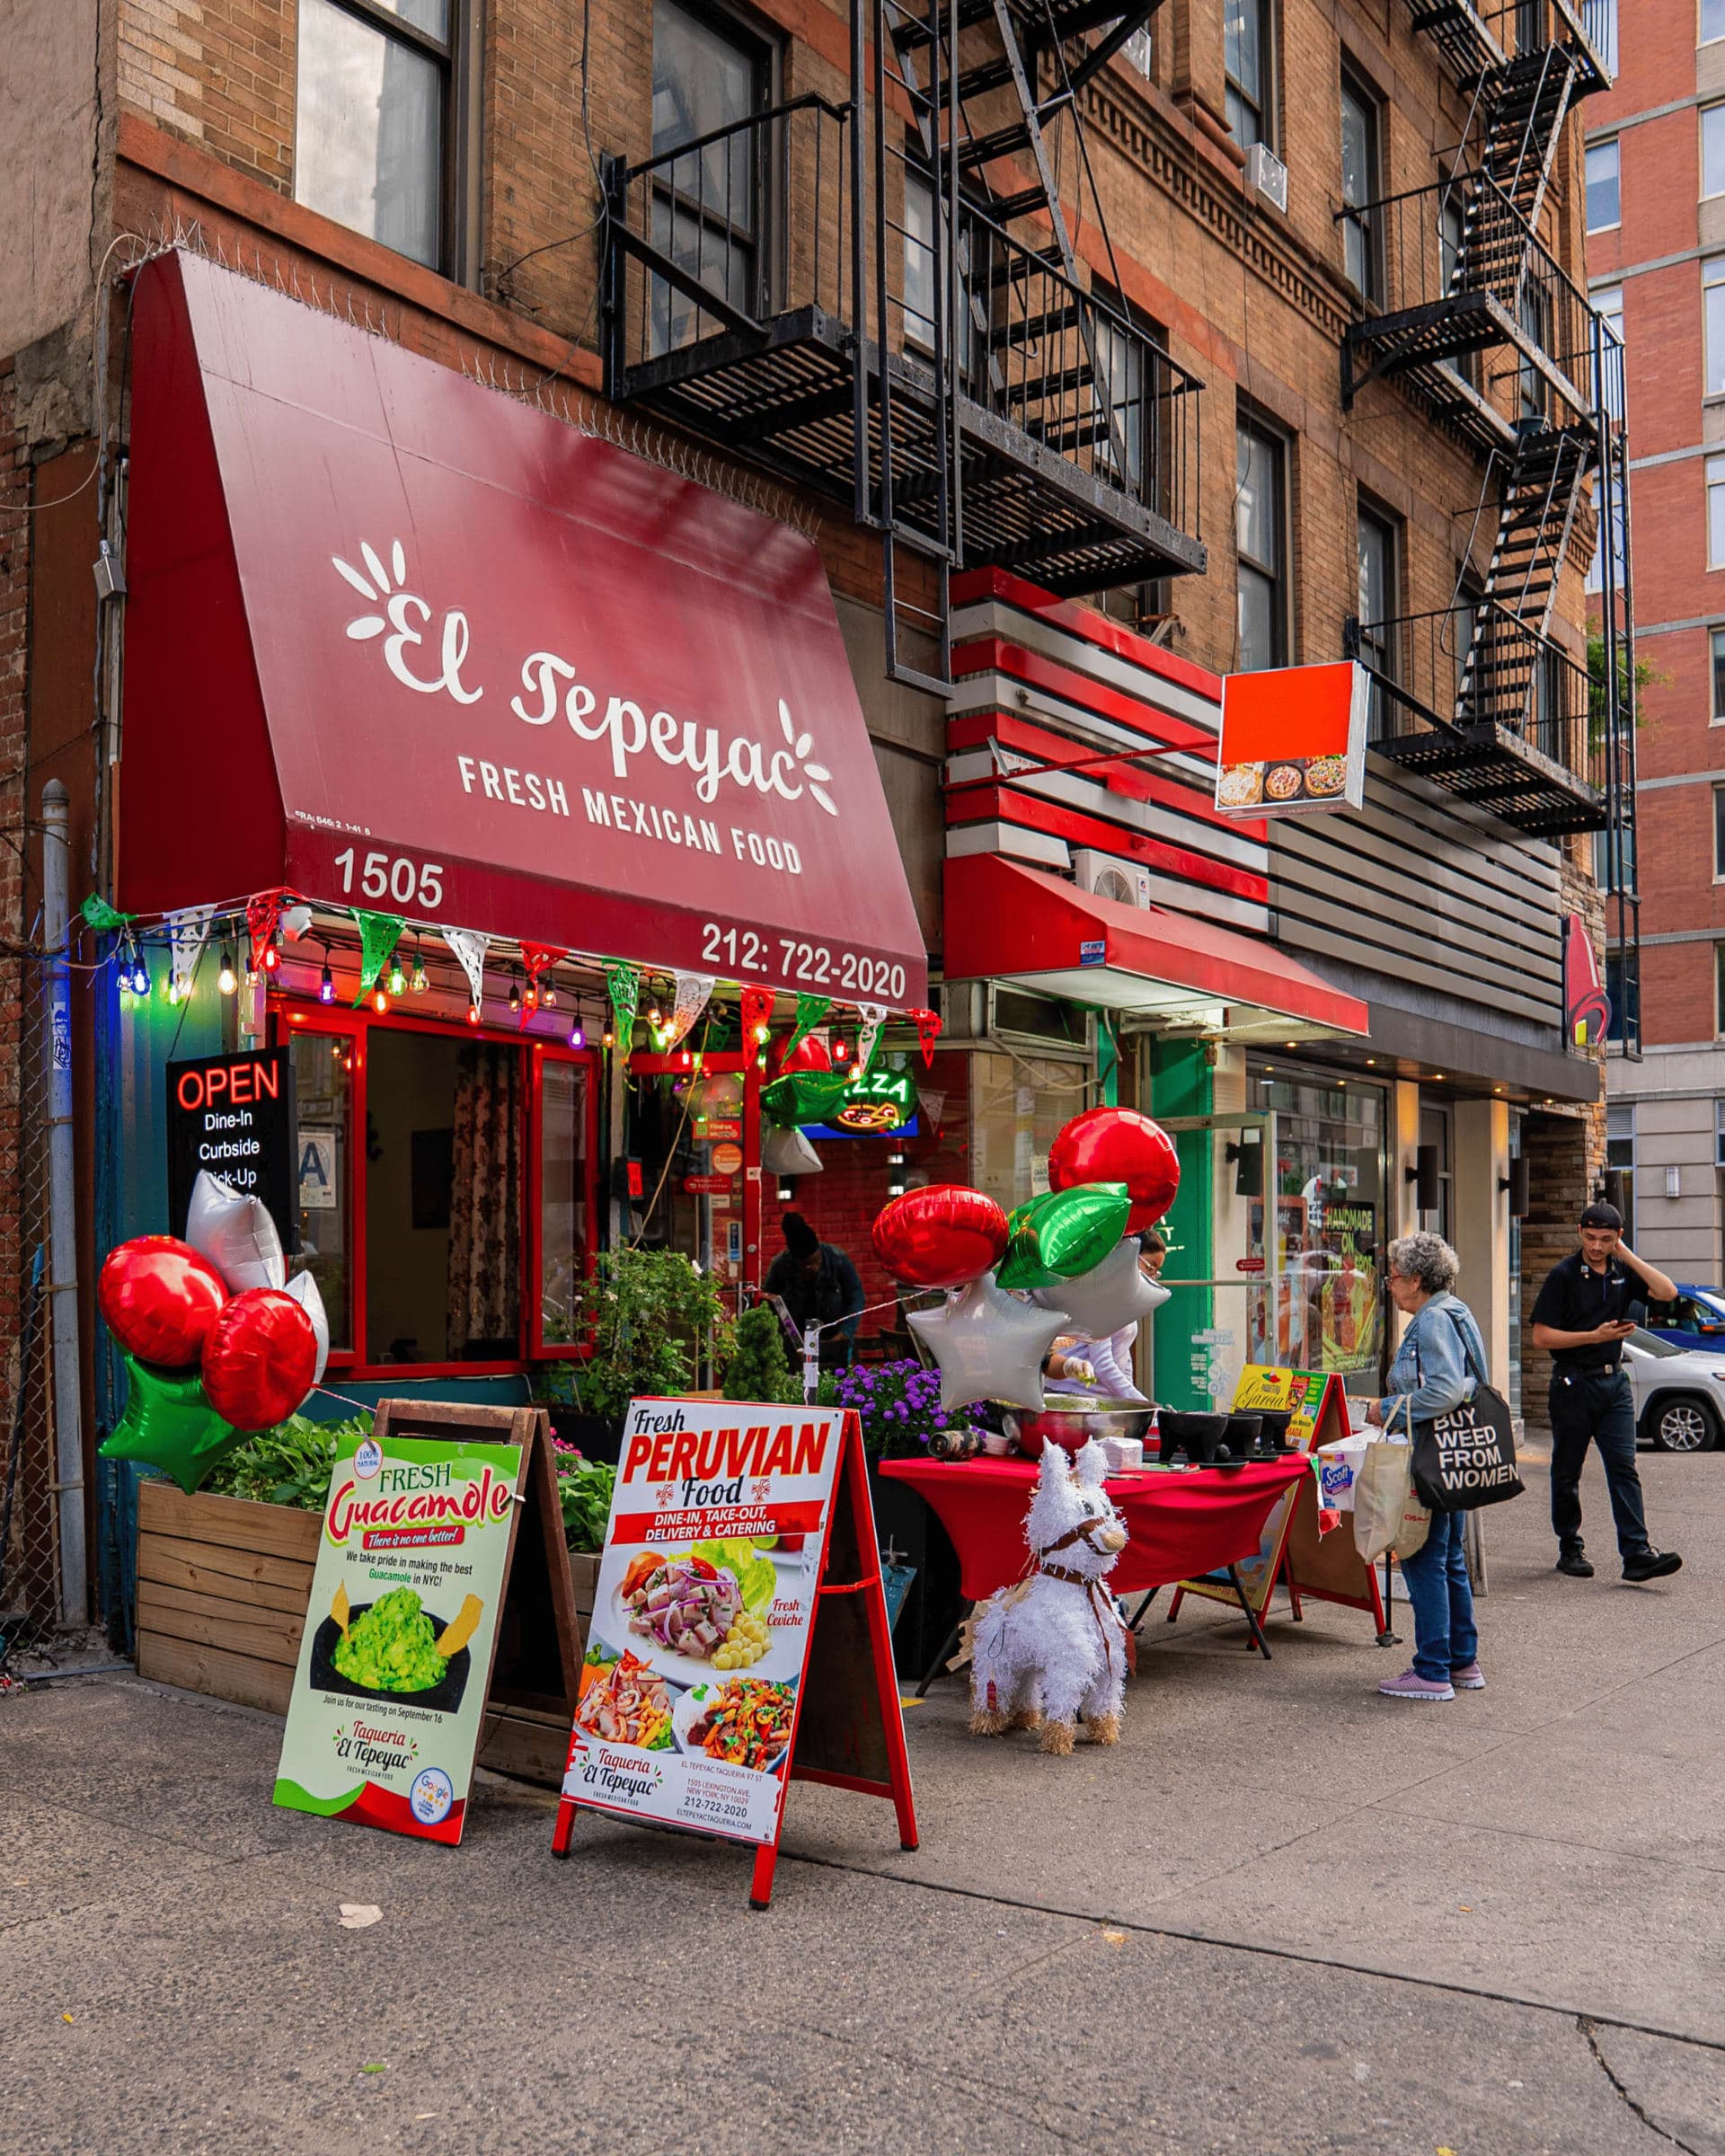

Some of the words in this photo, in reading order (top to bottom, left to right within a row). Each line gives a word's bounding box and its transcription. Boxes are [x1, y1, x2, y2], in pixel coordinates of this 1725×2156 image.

[385, 593, 483, 704] El
[510, 651, 806, 803] Tepeyac
[457, 755, 570, 817] FRESH
[582, 788, 722, 855] MEXICAN
[730, 827, 802, 875] FOOD
[334, 848, 445, 908] 1505
[702, 923, 769, 973] 212:
[780, 938, 907, 1001] 722-2020
[177, 1059, 279, 1110] OPEN
[205, 1109, 252, 1131] Dine-In
[199, 1138, 260, 1161] Curbside
[298, 1142, 328, 1186] A
[213, 1168, 257, 1188] ick-Up
[1327, 1207, 1373, 1232] HANDMADE
[1341, 1232, 1354, 1254] ON
[634, 1409, 685, 1434] Fresh
[1434, 1408, 1475, 1431] BUY
[1434, 1426, 1496, 1449] WEED
[622, 1422, 831, 1484] PERUVIAN
[1438, 1445, 1502, 1469] FROM
[379, 1463, 452, 1492] FRESH
[1326, 1465, 1349, 1486] Scott
[1441, 1463, 1519, 1490] WOMEN
[682, 1475, 744, 1507] Food
[328, 1467, 509, 1540] Guacamole
[655, 1512, 703, 1527] DINE-IN,
[705, 1506, 767, 1523] TAKE-OUT,
[1404, 1514, 1417, 1522] CVS
[368, 1533, 392, 1547] There
[393, 1534, 400, 1545] is
[400, 1536, 411, 1545] no
[413, 1535, 427, 1544] one
[429, 1527, 458, 1542] better!
[646, 1525, 701, 1541] DELIVERY
[703, 1525, 712, 1537] &
[714, 1520, 775, 1536] CATERING
[346, 1551, 358, 1561] We
[359, 1552, 376, 1563] take
[377, 1555, 397, 1567] pride
[400, 1557, 407, 1567] in
[409, 1559, 438, 1573] making
[440, 1561, 452, 1573] the
[455, 1563, 473, 1575] best
[369, 1568, 411, 1583] Guacamole
[413, 1574, 420, 1584] in
[423, 1575, 442, 1586] NYC!
[773, 1598, 800, 1613] Fresh
[767, 1613, 803, 1626] Ceviche
[323, 1694, 336, 1704] Join
[345, 1698, 354, 1708] for
[367, 1703, 387, 1716] tasting
[398, 1707, 433, 1721] September
[435, 1714, 442, 1724] 16
[353, 1720, 406, 1746] Taqueria
[338, 1738, 352, 1757] El
[354, 1741, 410, 1772] Tepeyac
[599, 1748, 650, 1773] Taqueria
[346, 1765, 360, 1773] FRESH
[361, 1767, 381, 1778] MEXICAN
[584, 1764, 598, 1784] El
[600, 1767, 654, 1798] Tepeyac
[689, 1762, 715, 1773] TEPEYAC
[716, 1767, 745, 1779] TAQUERIA
[421, 1775, 448, 1799] Google
[686, 1787, 701, 1796] NEW
[731, 1795, 748, 1805] 10029
[687, 1779, 701, 1788] 1505
[702, 1780, 736, 1795] LEXINGTON
[677, 1807, 752, 1830] ELTEPEYACTAQUERIA.COM
[685, 1796, 748, 1817] 212-722-2020
